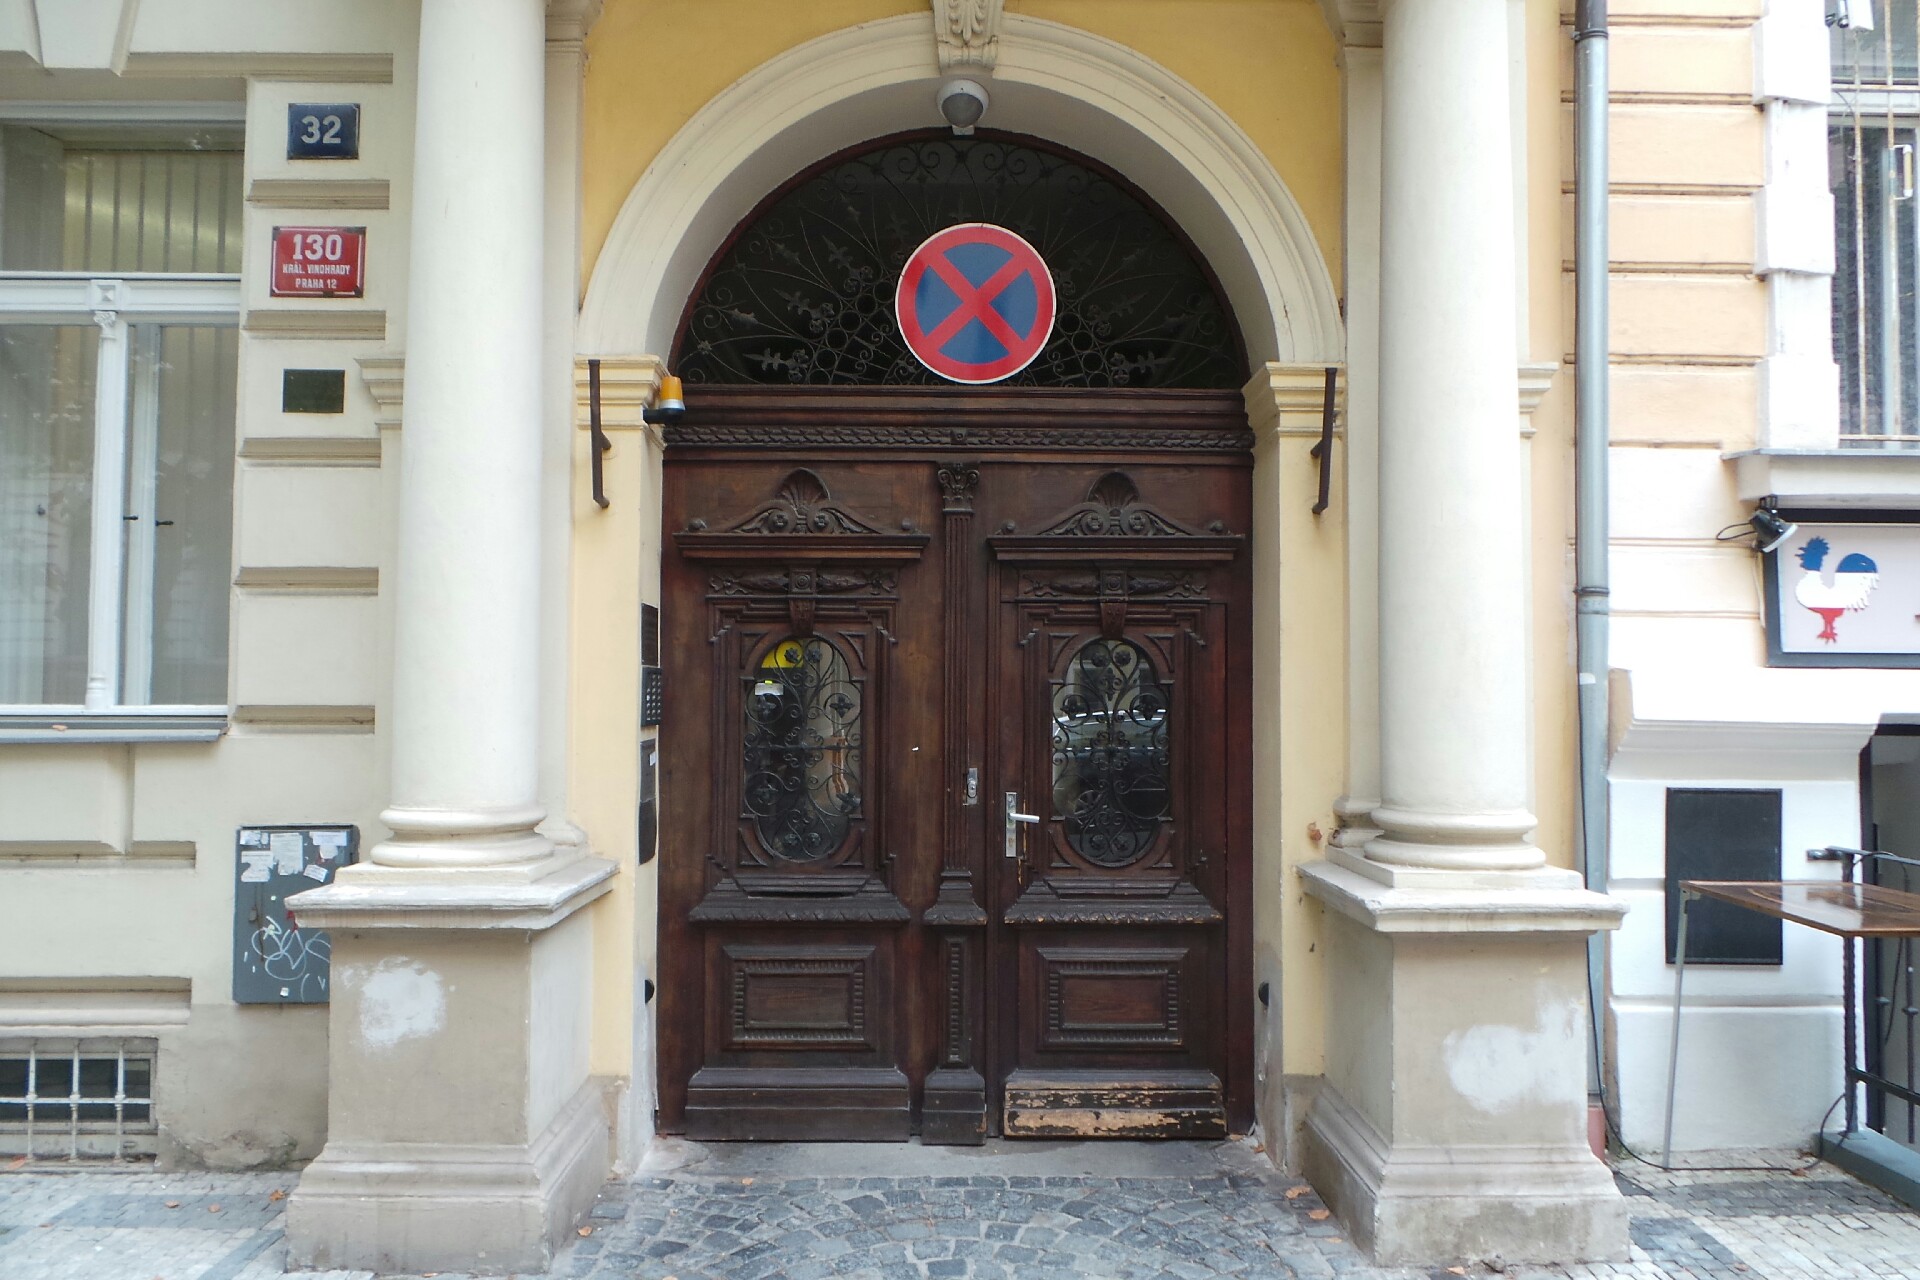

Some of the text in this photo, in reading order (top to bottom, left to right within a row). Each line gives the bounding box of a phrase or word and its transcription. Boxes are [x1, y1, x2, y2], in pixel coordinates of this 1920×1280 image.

[301, 115, 341, 144] 32
[292, 233, 342, 261] 130
[307, 264, 351, 275] VINOHRADY
[295, 278, 337, 289] PRAHA 12
